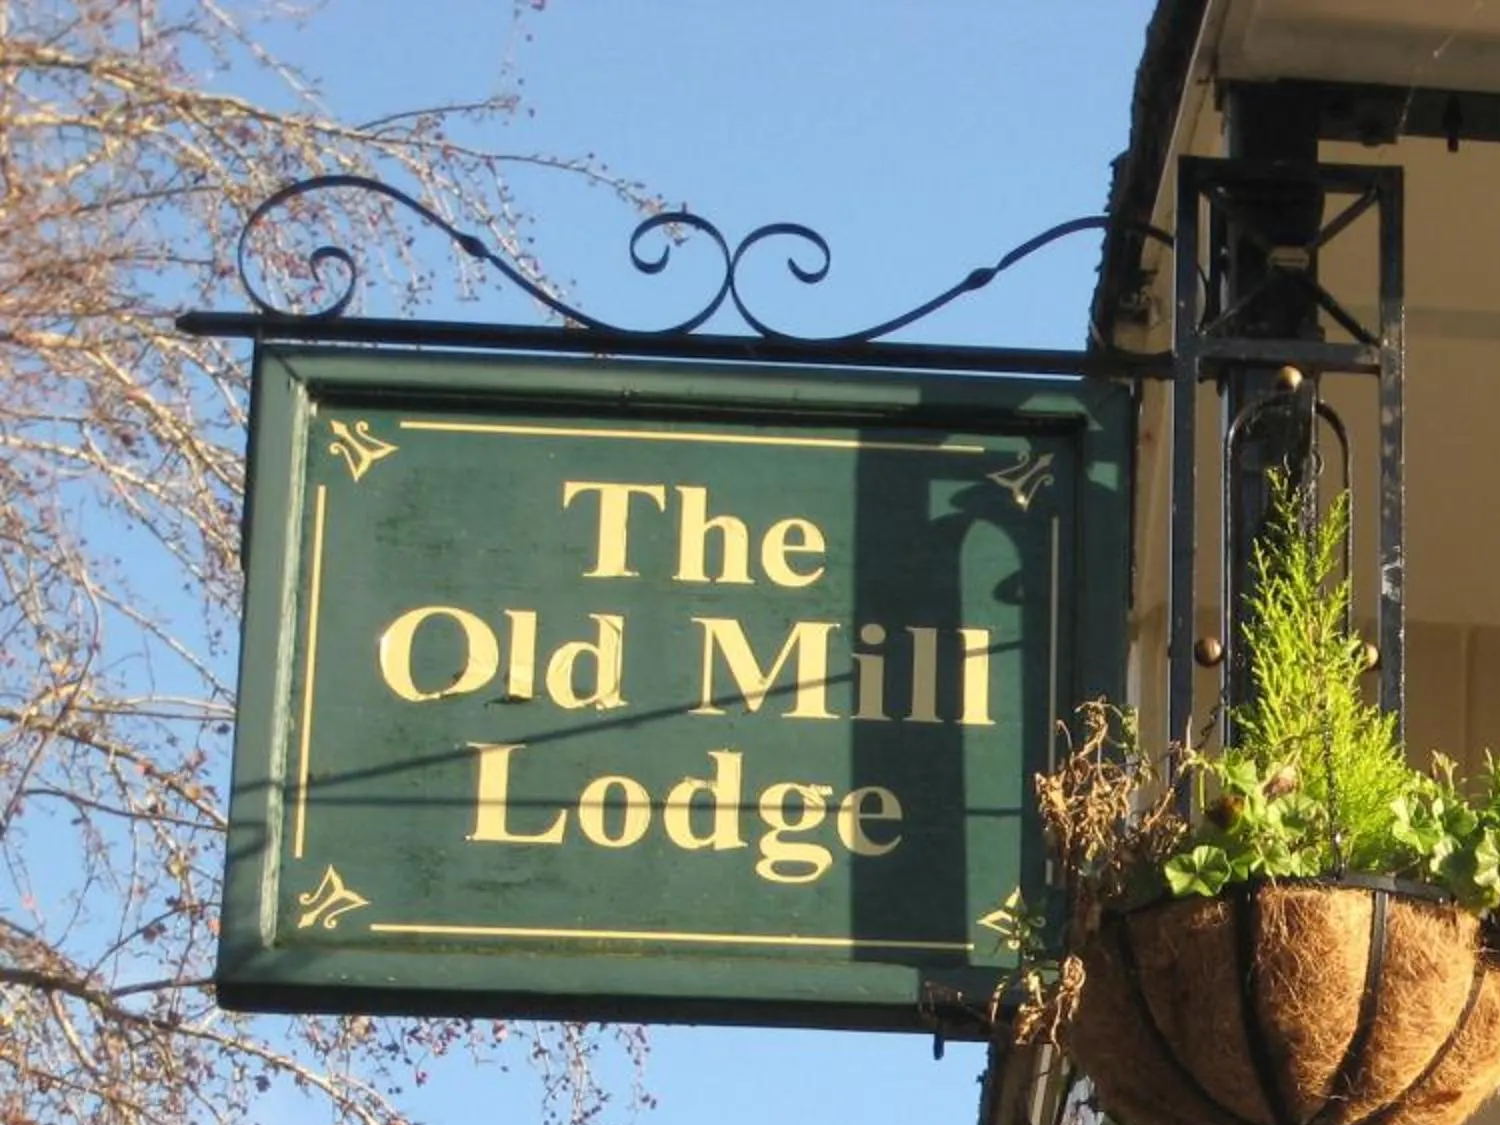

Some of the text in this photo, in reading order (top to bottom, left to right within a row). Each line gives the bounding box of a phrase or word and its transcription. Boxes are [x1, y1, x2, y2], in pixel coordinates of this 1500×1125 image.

[562, 480, 827, 587] The
[378, 606, 996, 726] Old Mill
[465, 741, 904, 885] Lodge
